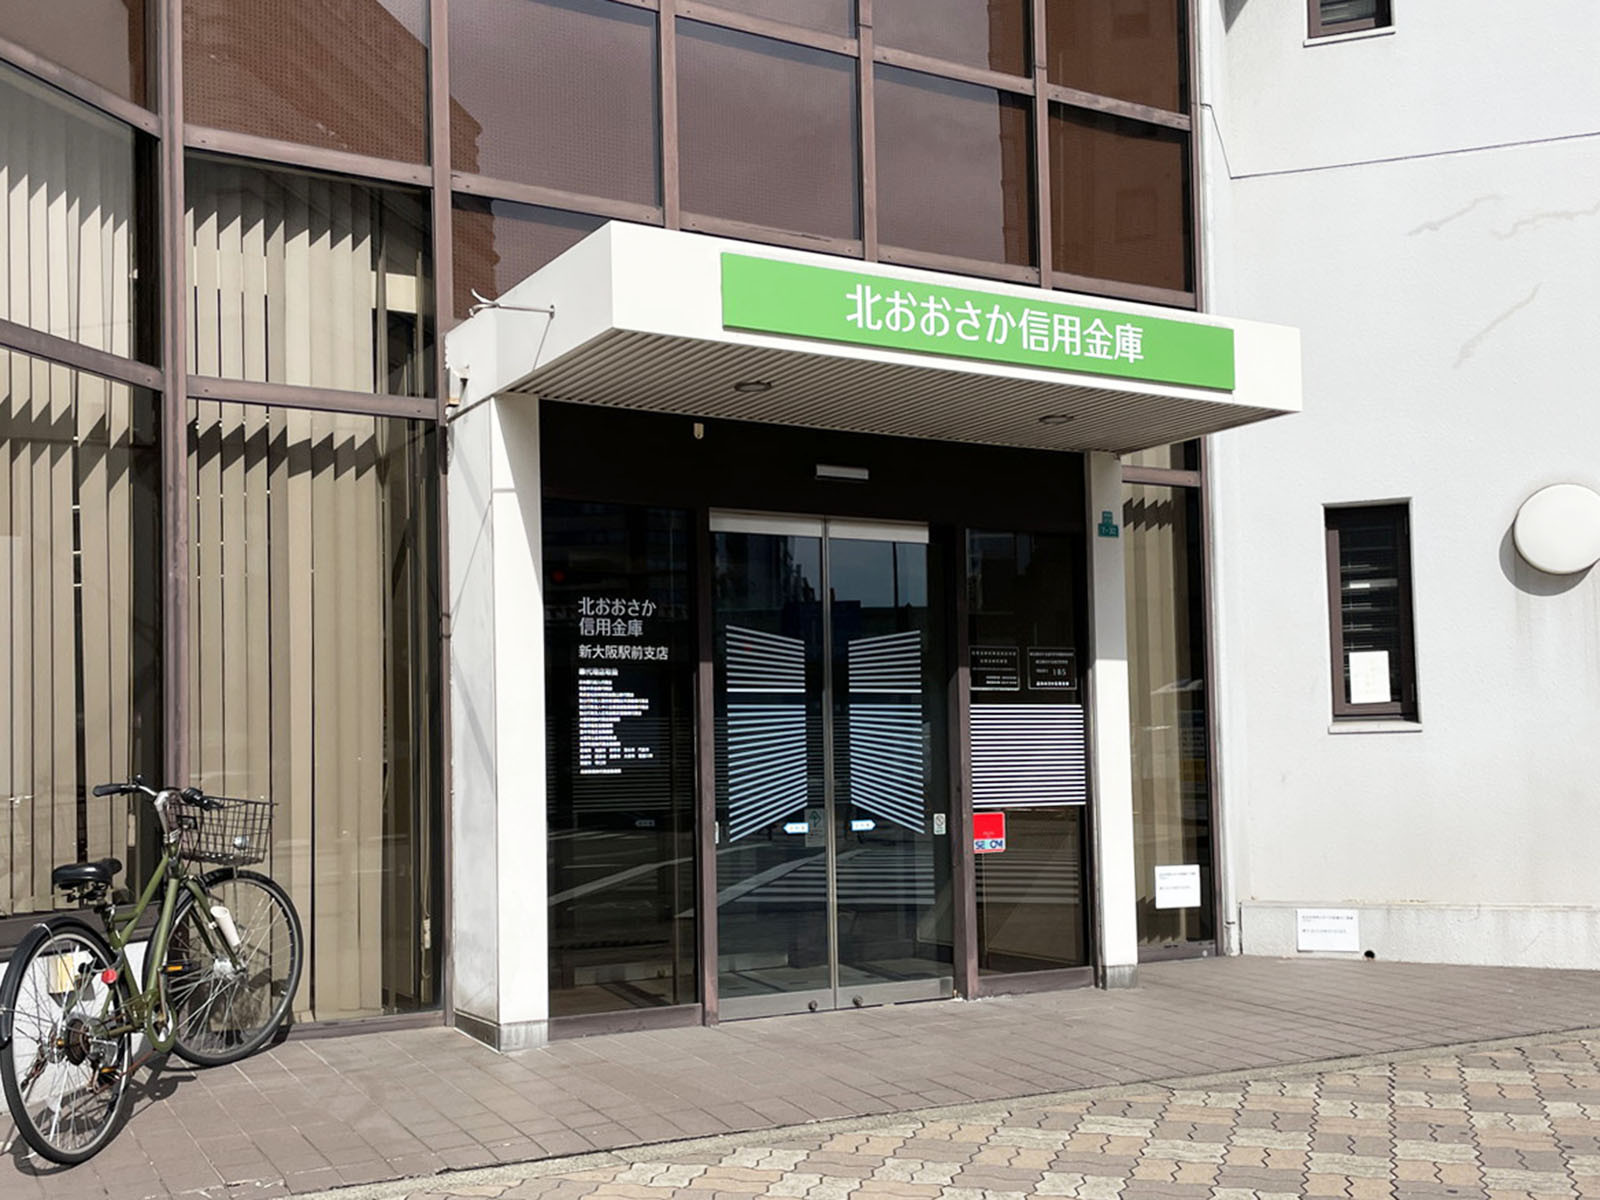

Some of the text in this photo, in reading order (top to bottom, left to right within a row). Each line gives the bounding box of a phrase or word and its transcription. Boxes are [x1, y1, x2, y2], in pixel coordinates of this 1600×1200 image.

[846, 284, 1145, 364] 北おおさか信用金庫
[578, 596, 657, 617] 北おおさか
[579, 617, 644, 637] 信用金庫
[578, 644, 669, 661] 新大阪駅前支店
